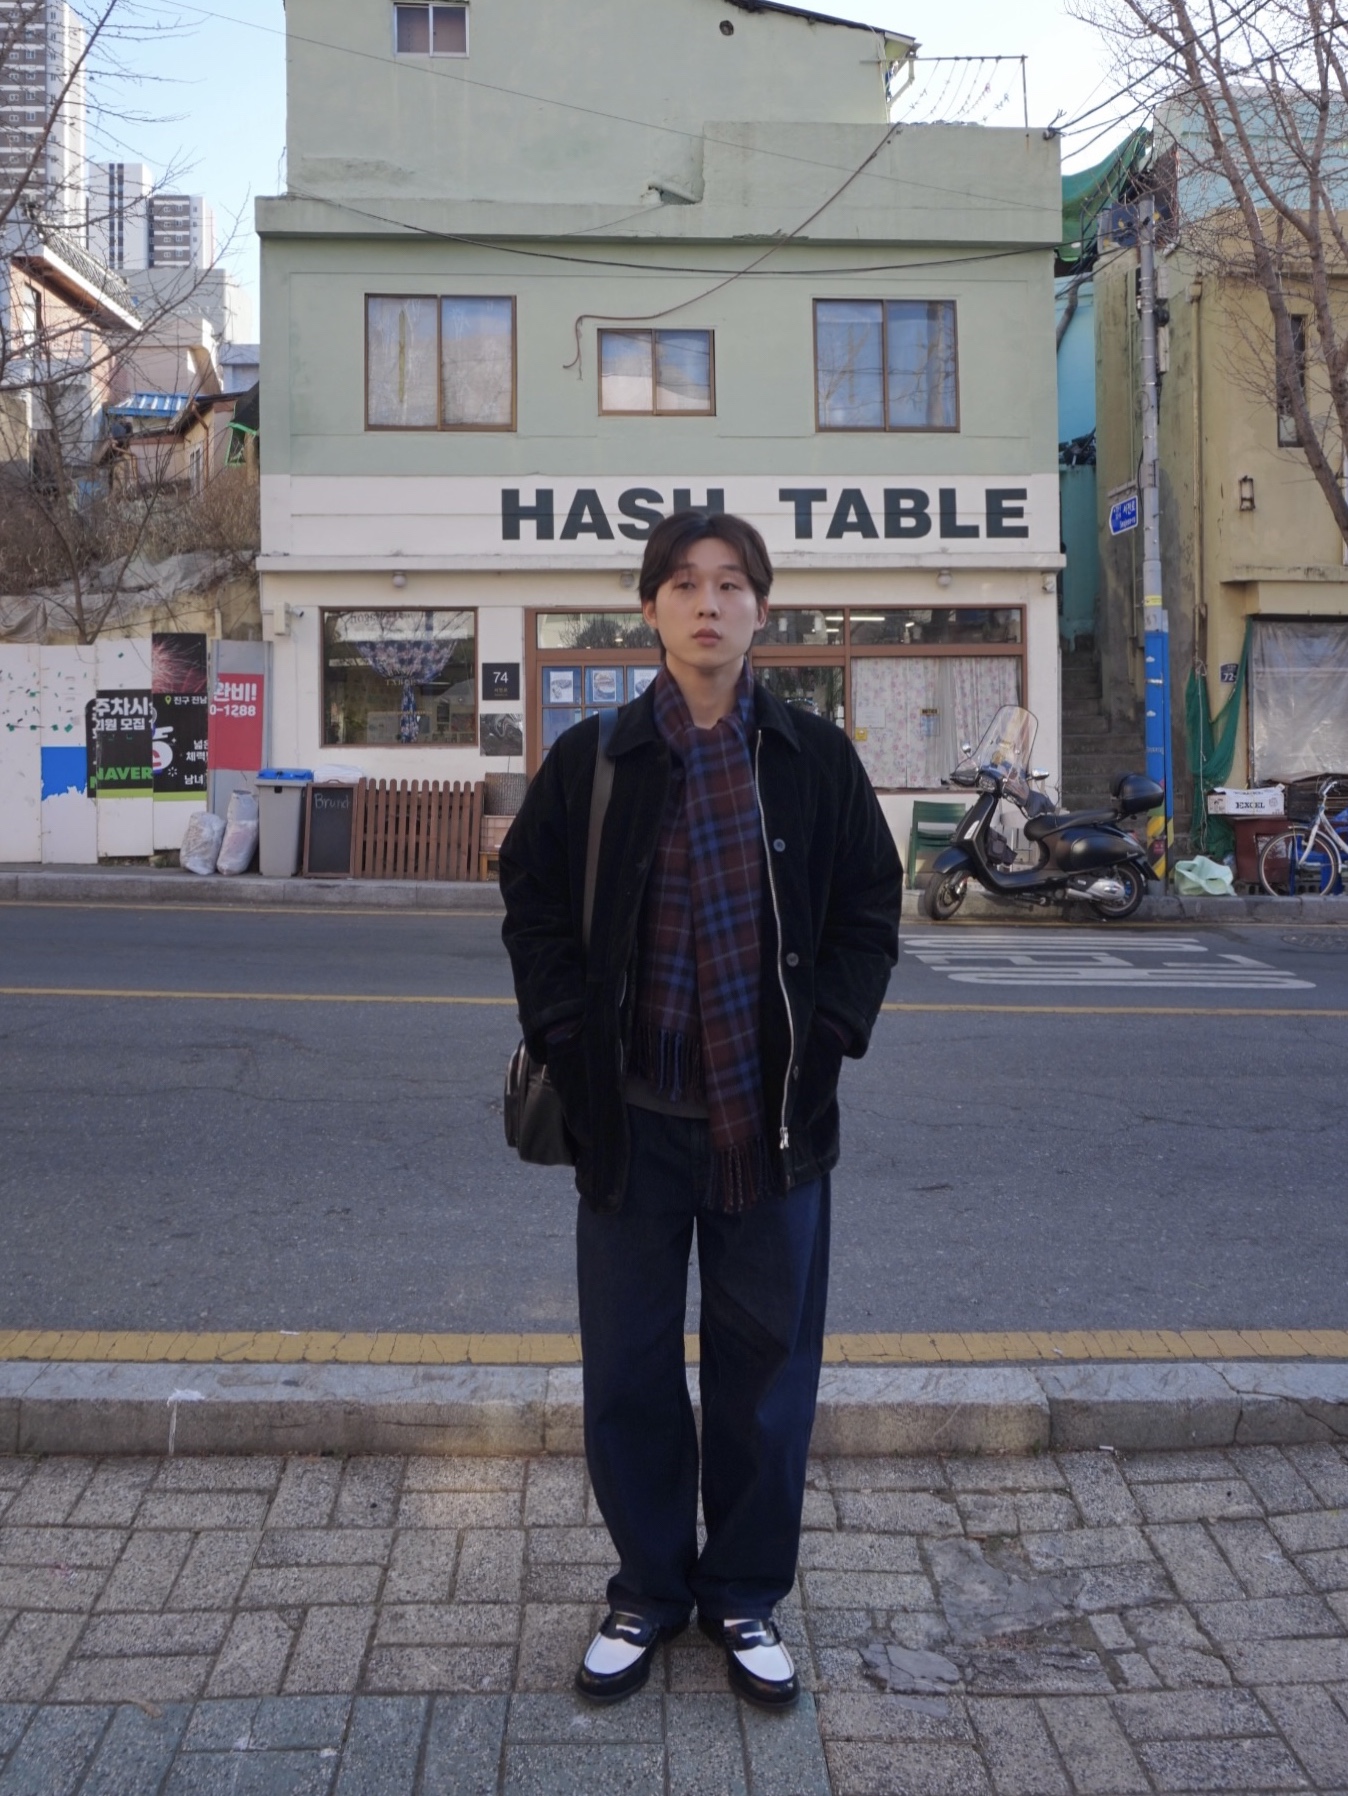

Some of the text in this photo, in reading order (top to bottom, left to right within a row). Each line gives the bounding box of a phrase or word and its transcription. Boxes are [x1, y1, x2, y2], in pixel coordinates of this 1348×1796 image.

[501, 487, 1029, 540] HASH TABLE
[493, 671, 509, 684] 74
[120, 718, 145, 731] 모집
[186, 751, 208, 762] 체력
[90, 766, 153, 786] NAVER
[184, 774, 204, 785] 남녀
